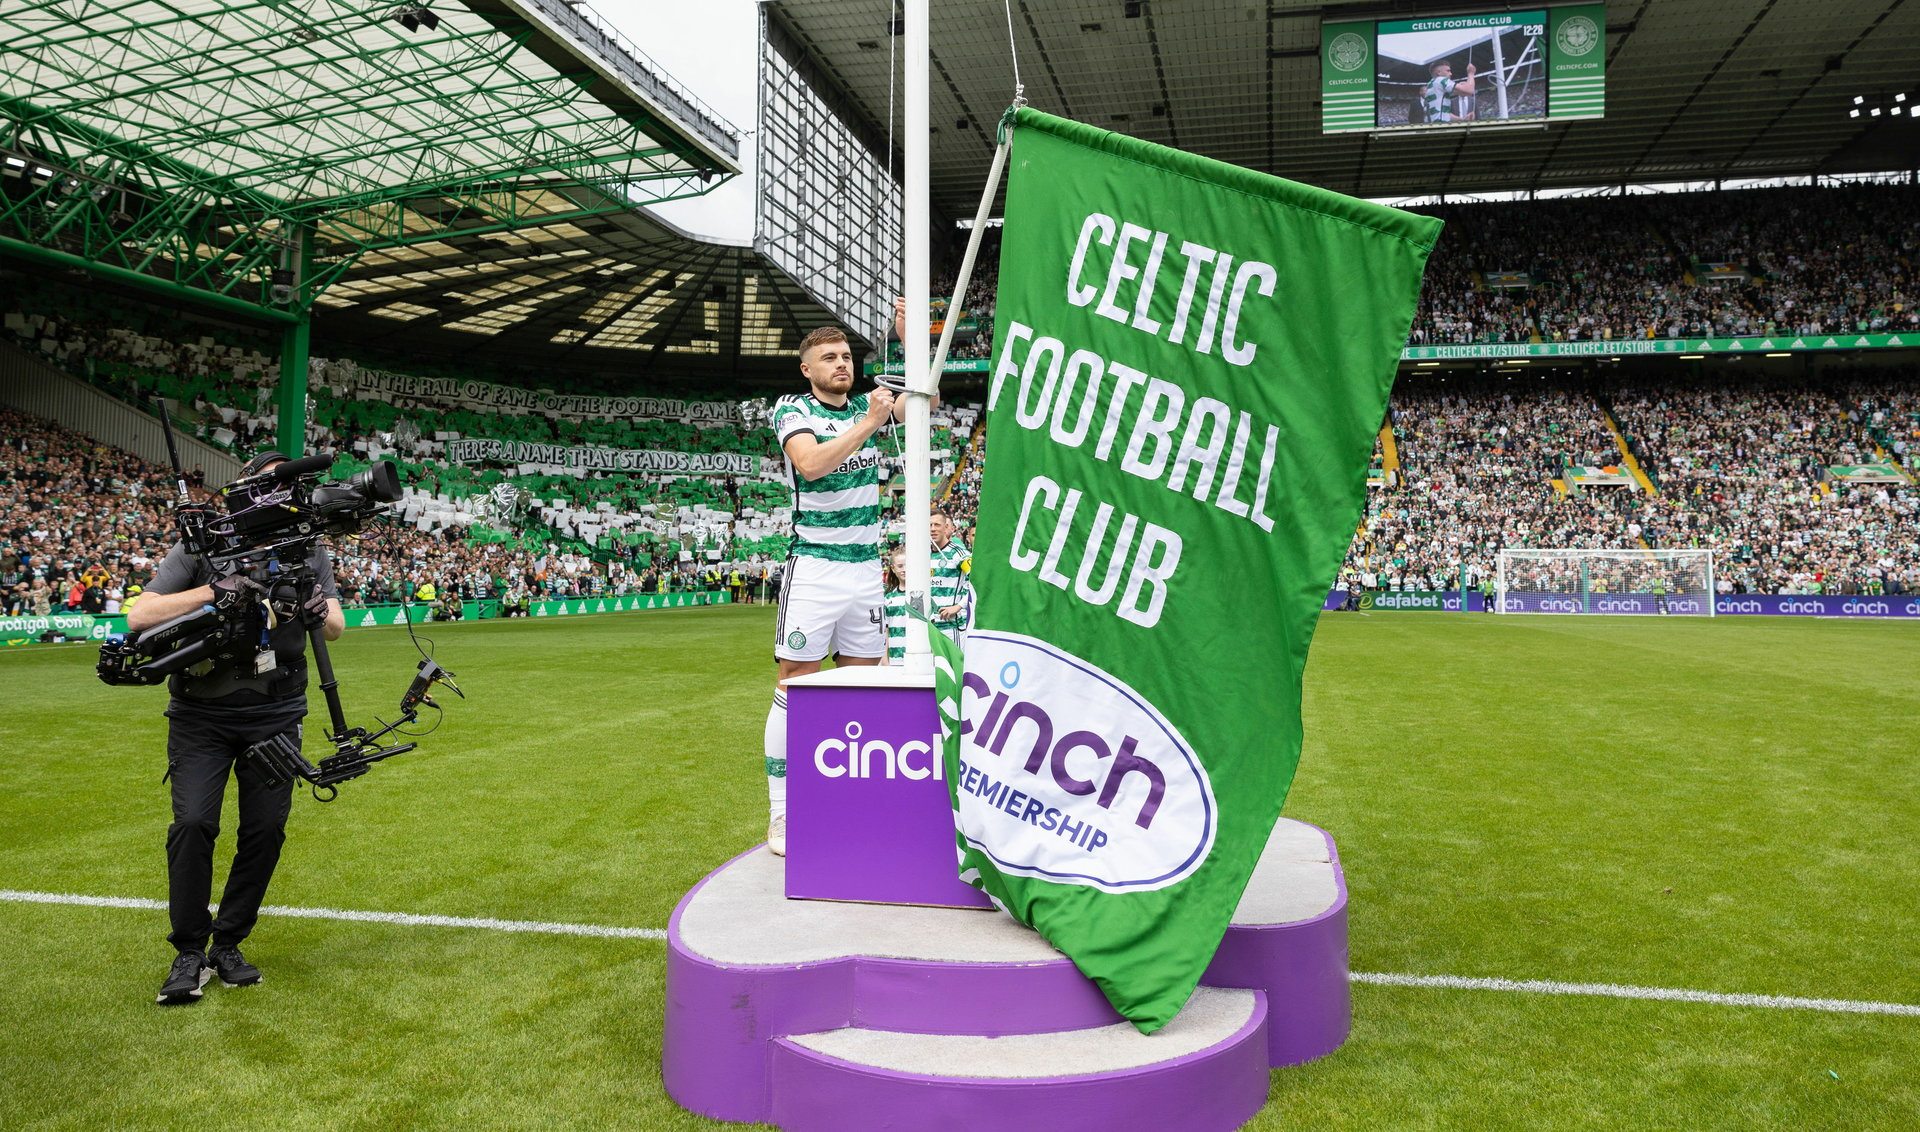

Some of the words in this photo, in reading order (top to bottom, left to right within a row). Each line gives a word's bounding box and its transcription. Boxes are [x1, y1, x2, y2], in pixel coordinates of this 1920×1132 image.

[1412, 22, 1441, 30] CELTIC
[1443, 18, 1487, 28] FOOTBALL
[1489, 16, 1512, 25] CLUB
[1556, 62, 1599, 70] CELTICFC.COM
[1067, 213, 1277, 366] CELTIC
[1436, 344, 1532, 358] CELTICFC.NET/STORE
[1557, 341, 1656, 355] CELTICFC.NET/STORE
[359, 369, 381, 388] IN
[384, 374, 416, 395] THE
[420, 377, 460, 397] HALL
[464, 381, 489, 399] OF
[492, 386, 539, 408] FAME
[544, 396, 568, 410] OF
[570, 397, 600, 413] THE
[604, 397, 686, 417] FOOTBALL
[689, 402, 737, 420] GAME
[988, 321, 1279, 533] FOOTBALL
[450, 440, 502, 463] THERE'S
[502, 443, 516, 461] A
[518, 443, 566, 466] NAME
[569, 448, 618, 468] THAT
[618, 450, 689, 470] STANDS
[689, 453, 753, 473] ALONE
[832, 454, 876, 474] afabet
[1009, 475, 1183, 628] CLUB
[1375, 593, 1438, 609] dafabet
[1598, 596, 1641, 611] cinch
[1716, 597, 1762, 613] cinch
[1779, 598, 1825, 614] cinch
[1842, 599, 1889, 614] cinch
[0, 616, 49, 634] rodigal
[959, 759, 1108, 852] REMIERSHIP
